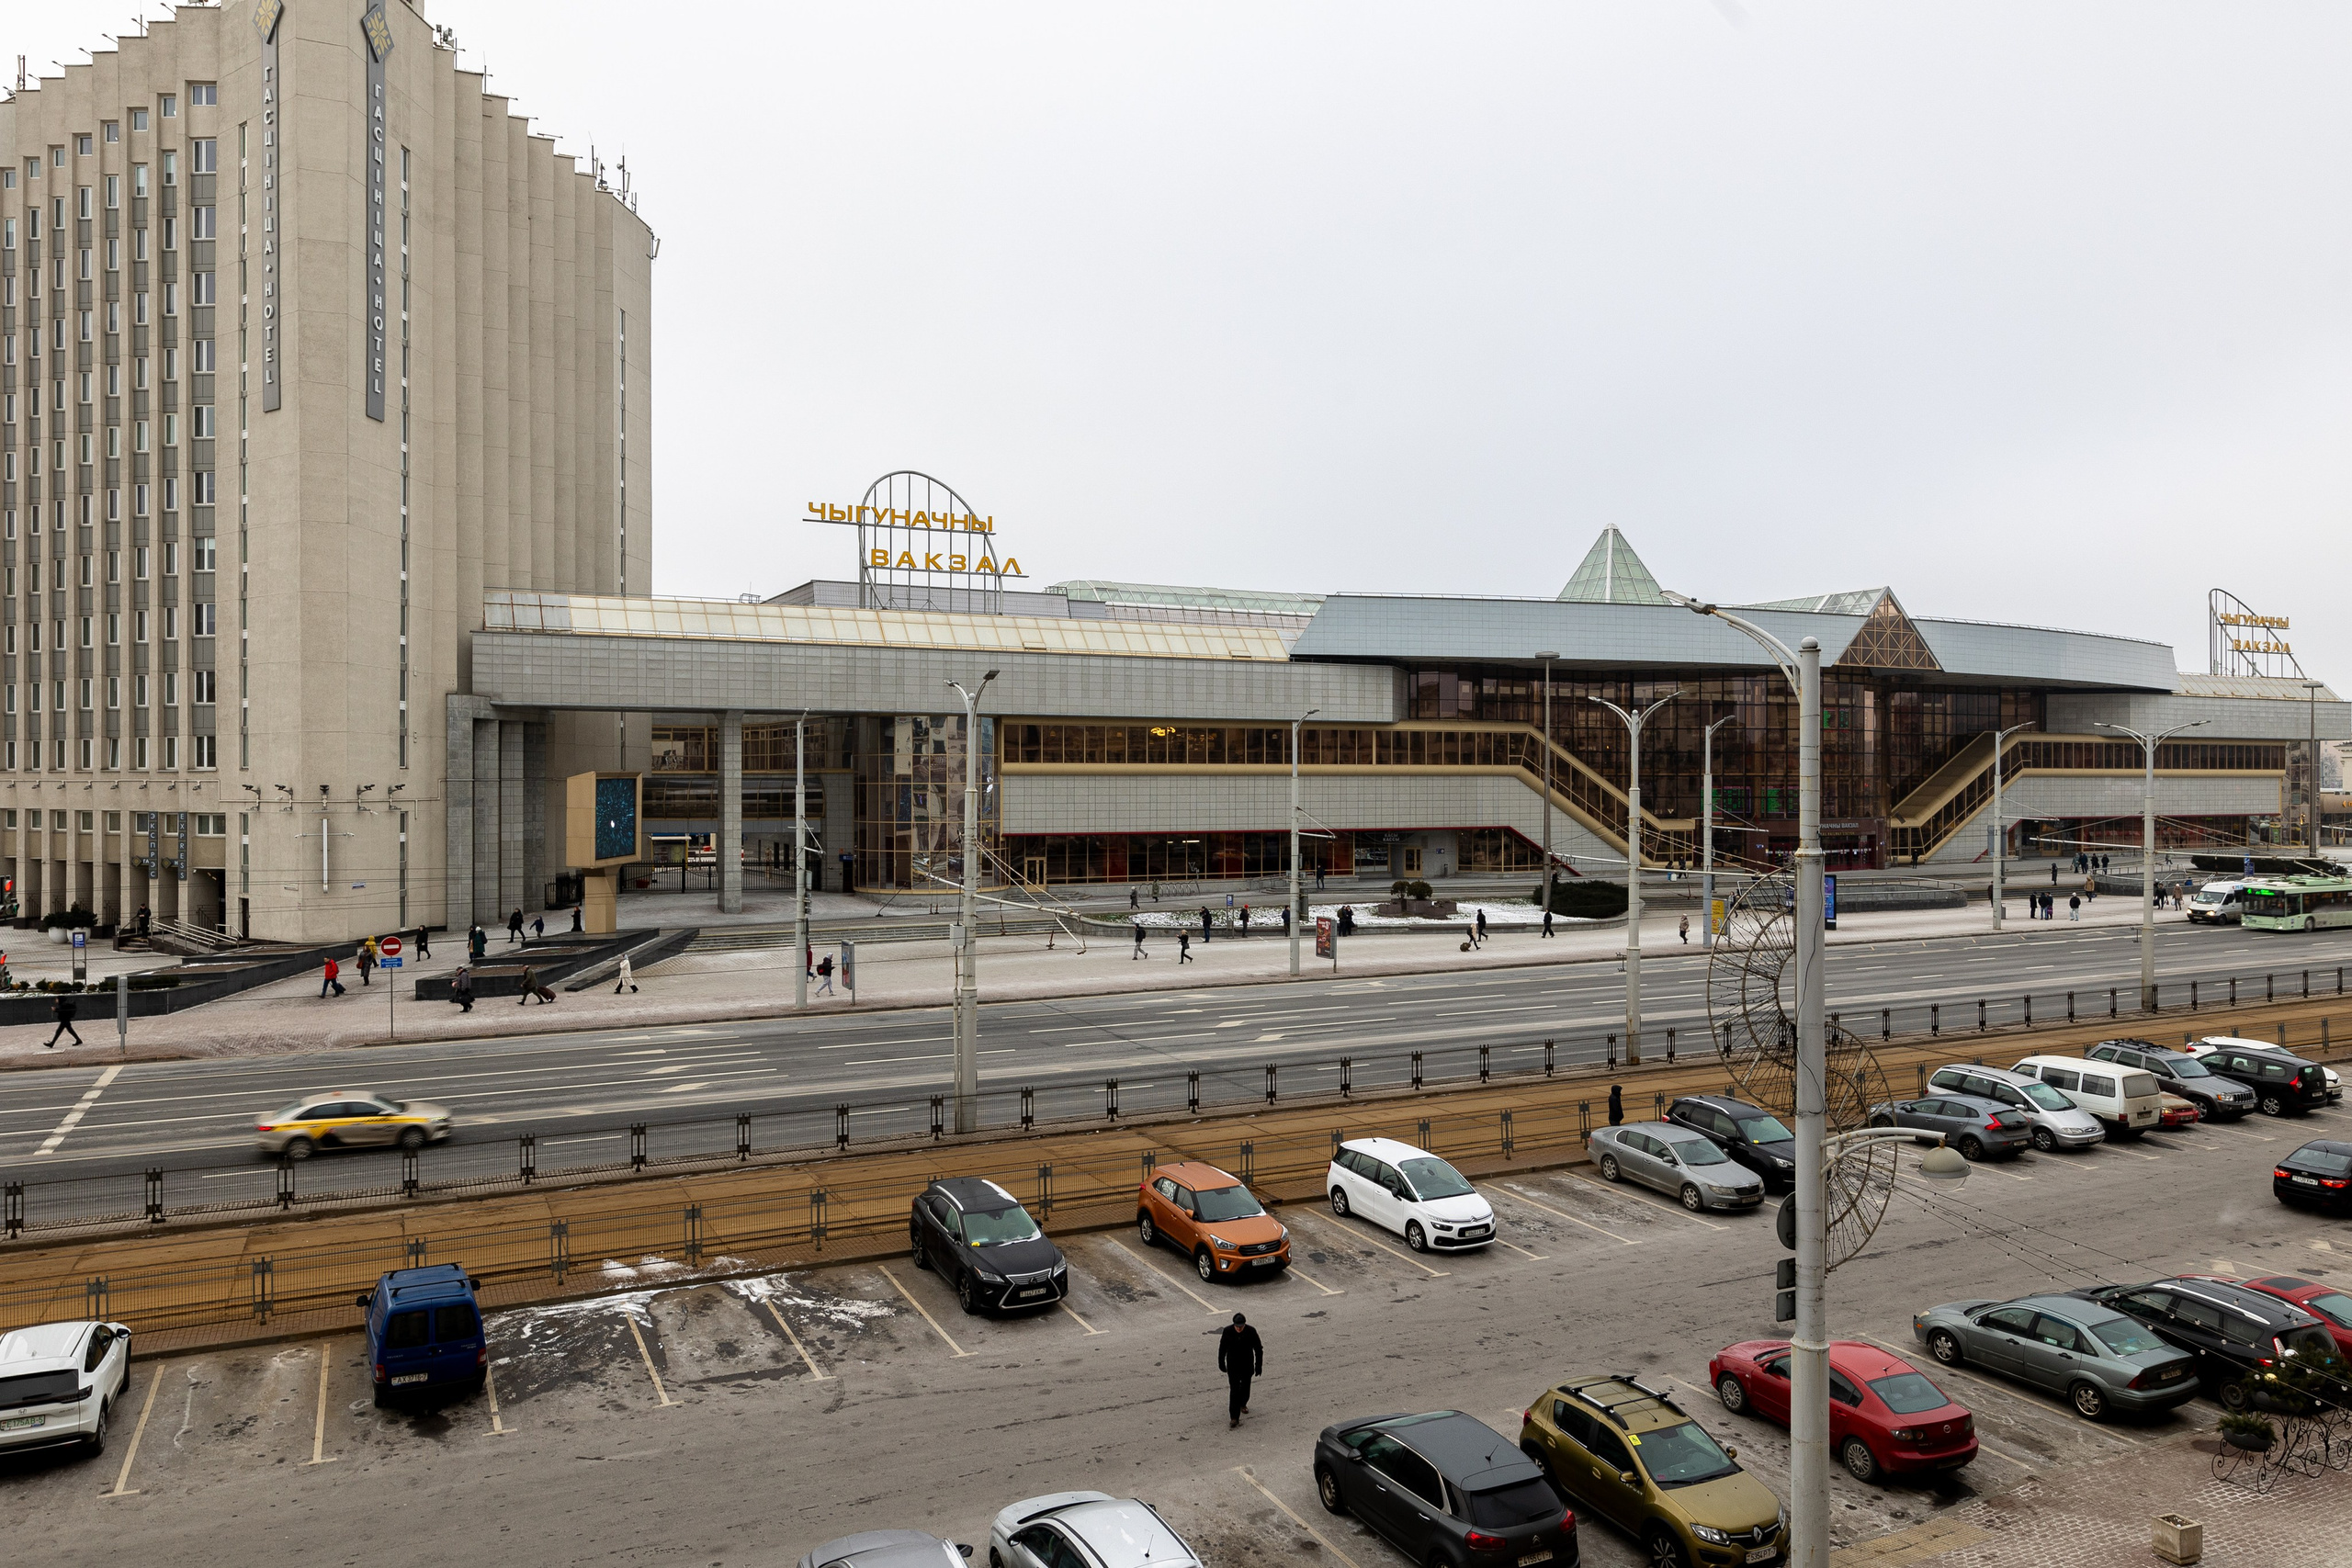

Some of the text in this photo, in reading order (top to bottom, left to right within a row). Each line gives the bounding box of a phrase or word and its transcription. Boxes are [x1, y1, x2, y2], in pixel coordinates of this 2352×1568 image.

[264, 66, 274, 254] ГАСЦІНІЦА
[373, 84, 383, 268] ГАСЦІНІЦА
[264, 282, 274, 384] HOTEL
[373, 294, 383, 394] HOTEL
[808, 502, 993, 533] ЧЫГУНАЧНЫ
[871, 548, 1022, 575] ВАКЗАЛ
[2220, 613, 2290, 627] ЧЫГУНАЧНЫ
[2233, 639, 2291, 653] ВАКЗАЛ
